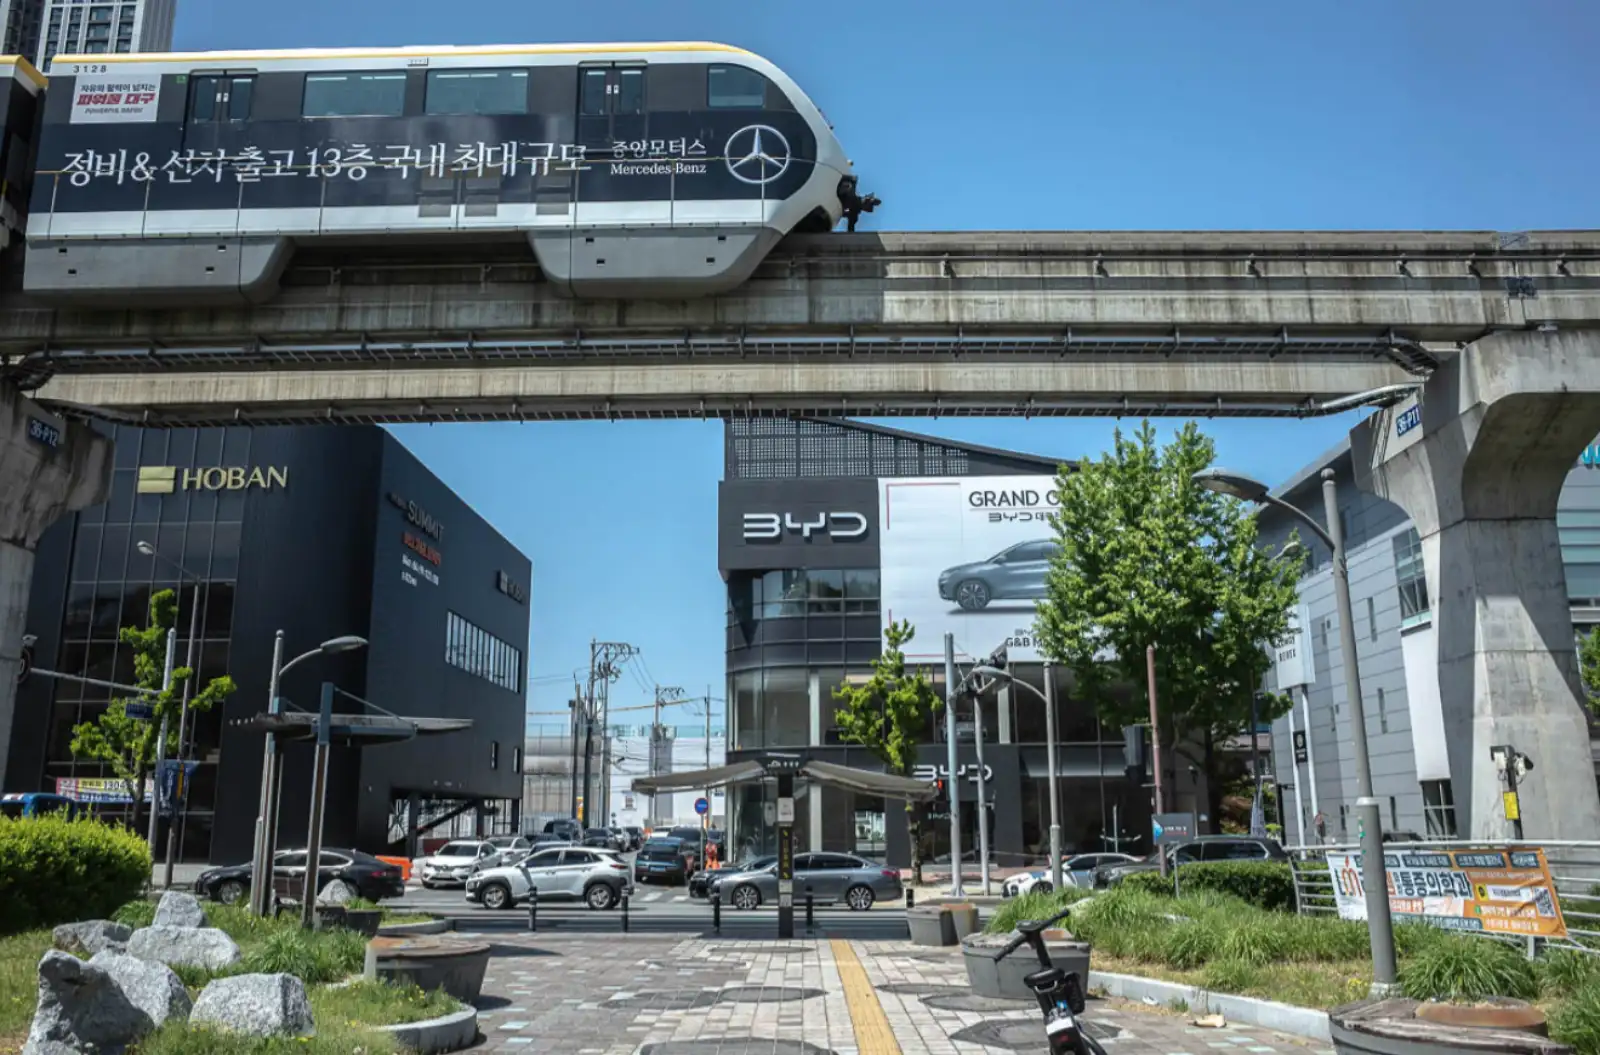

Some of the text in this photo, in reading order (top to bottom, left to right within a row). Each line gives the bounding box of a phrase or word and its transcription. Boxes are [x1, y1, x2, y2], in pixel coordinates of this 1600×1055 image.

[73, 65, 107, 74] 3128
[77, 92, 156, 106] 파워풀 대구
[611, 137, 707, 158] 중앙모터스
[231, 145, 299, 183] 출고
[305, 143, 376, 181] 13층
[379, 141, 445, 180] 국내
[450, 141, 517, 178] 최대
[610, 162, 707, 174] Mercedes-Benz
[182, 466, 288, 490] HOBAN
[968, 490, 1040, 507] GRAND
[743, 511, 868, 538] BYD
[988, 511, 1034, 522] BYD
[912, 764, 993, 782] BYD
[1400, 870, 1473, 898] 통증의학과
